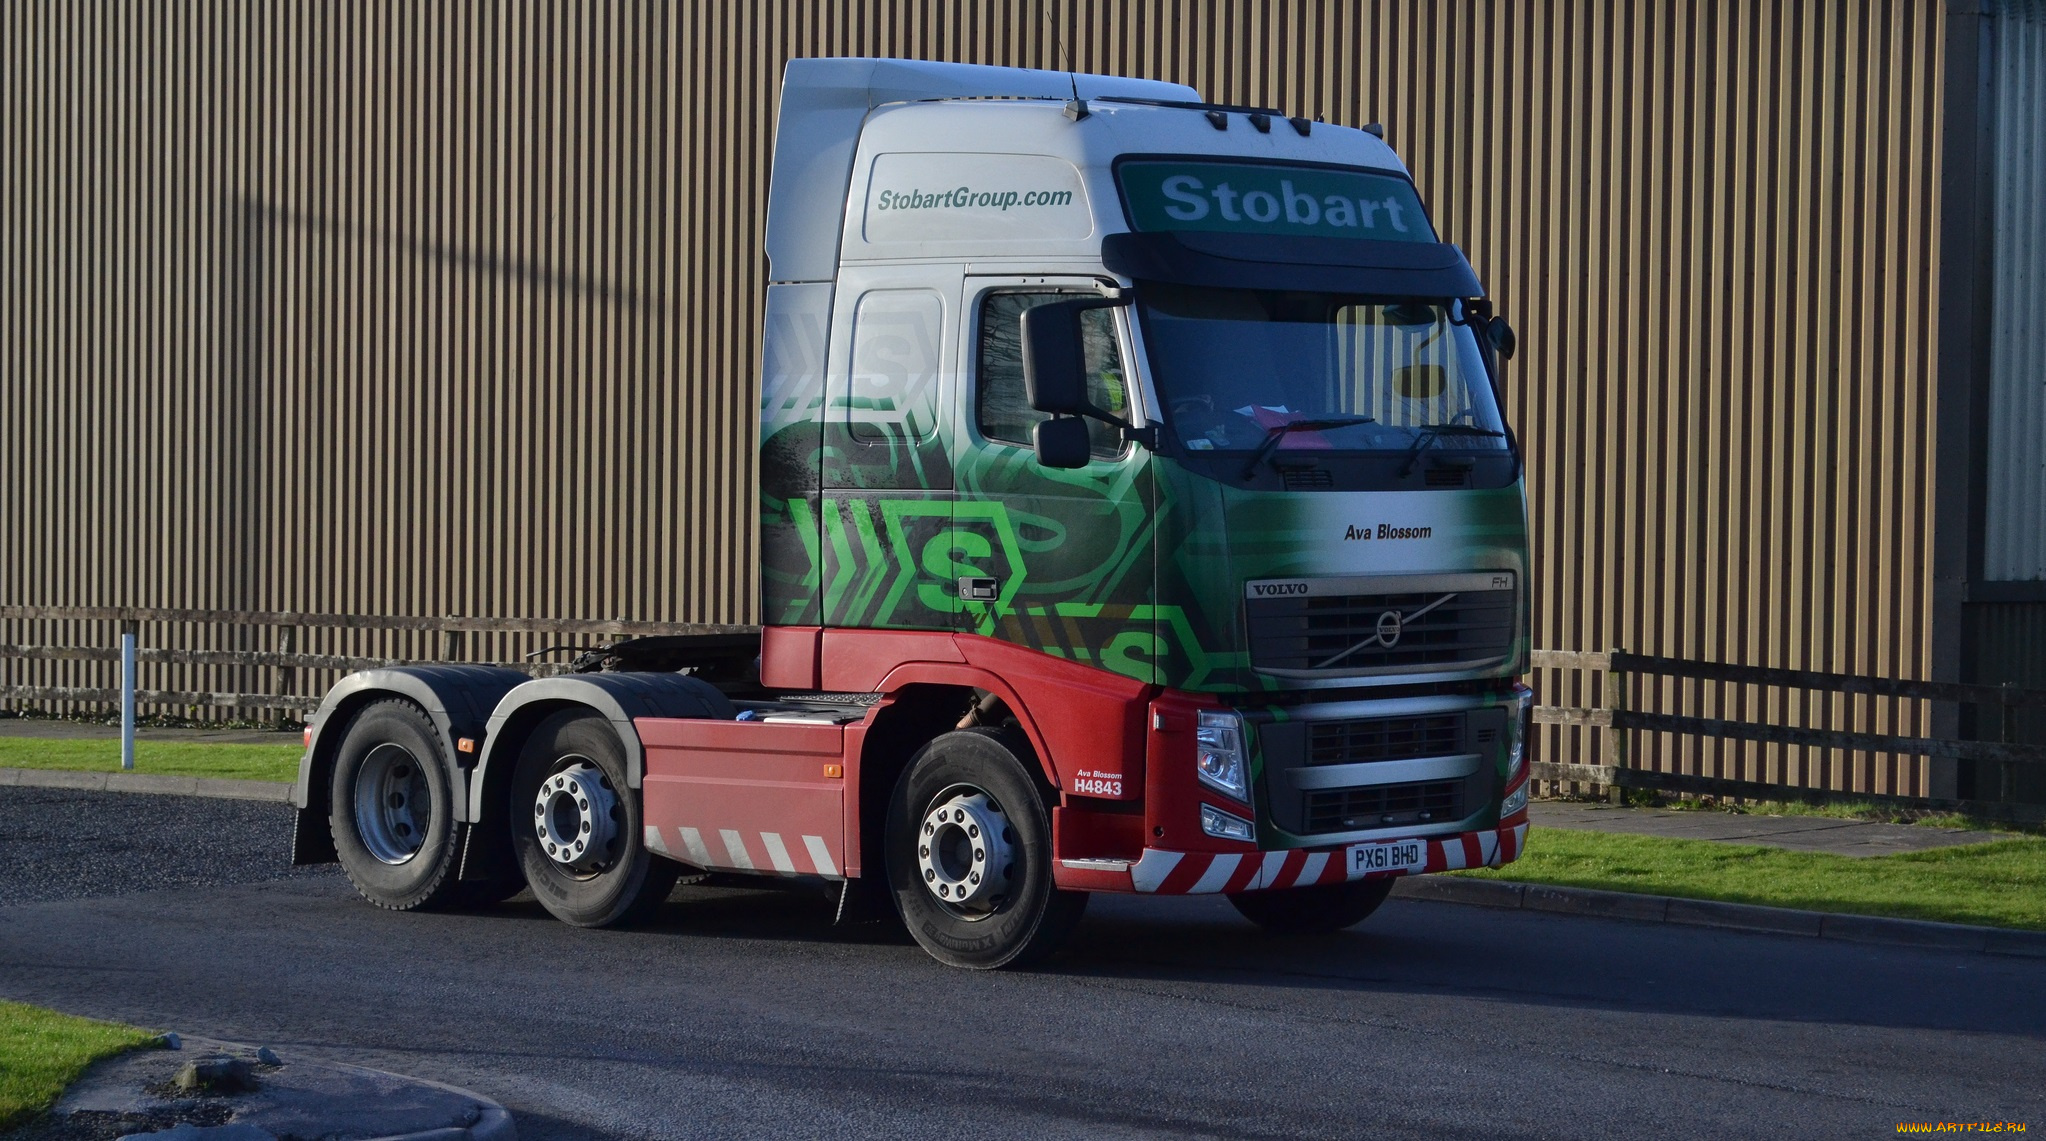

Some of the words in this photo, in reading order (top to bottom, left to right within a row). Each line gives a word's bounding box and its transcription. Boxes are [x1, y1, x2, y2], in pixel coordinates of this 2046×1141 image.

[877, 186, 1073, 212] StobartGroup.com
[1160, 174, 1409, 233] Stobart
[1344, 524, 1372, 541] Ava
[1377, 523, 1432, 540] Blossom
[1253, 583, 1308, 596] VOLVO
[1491, 576, 1508, 588] FH
[1077, 769, 1091, 777] Ava
[1093, 770, 1123, 780] Blossom
[1074, 778, 1122, 796] H4843
[1356, 847, 1388, 870] PX61
[1392, 844, 1419, 866] BHD
